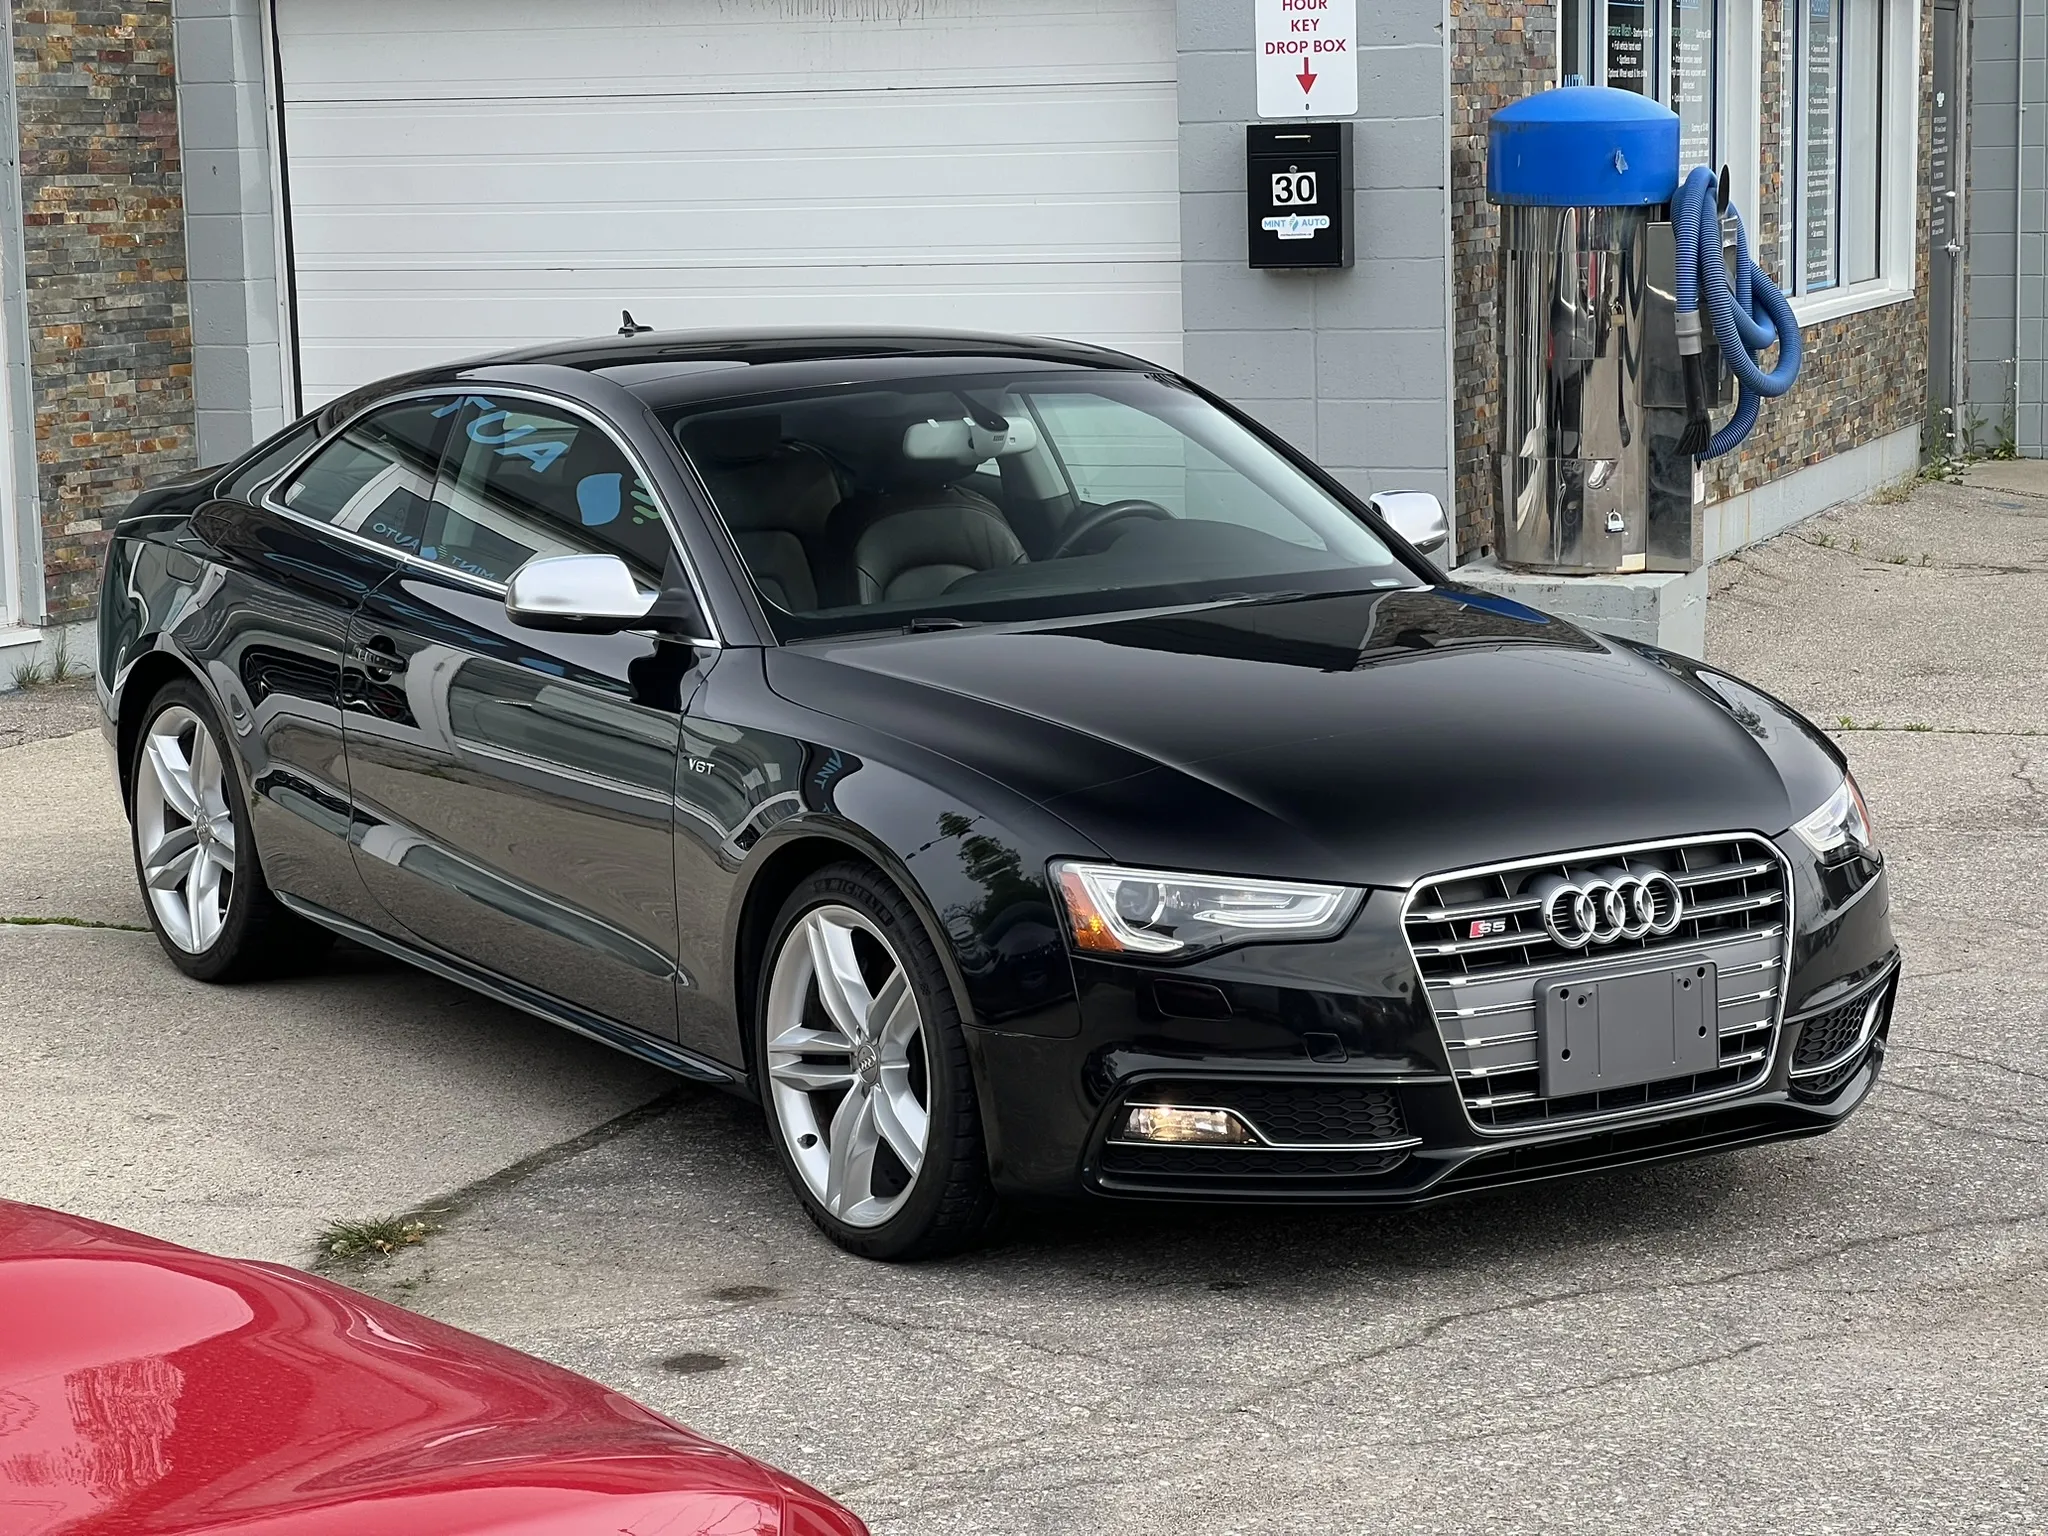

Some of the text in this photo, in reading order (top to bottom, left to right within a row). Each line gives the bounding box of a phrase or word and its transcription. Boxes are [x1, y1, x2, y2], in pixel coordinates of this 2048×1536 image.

[1283, 0, 1328, 11] HOUR
[1291, 18, 1320, 32] KEY
[1265, 39, 1346, 55] DROP BOX
[1275, 175, 1315, 203] 30
[1264, 218, 1328, 228] MINT AUTO
[688, 757, 715, 776] V6T
[827, 879, 893, 927] MICHELIN
[1475, 920, 1506, 935] S5
